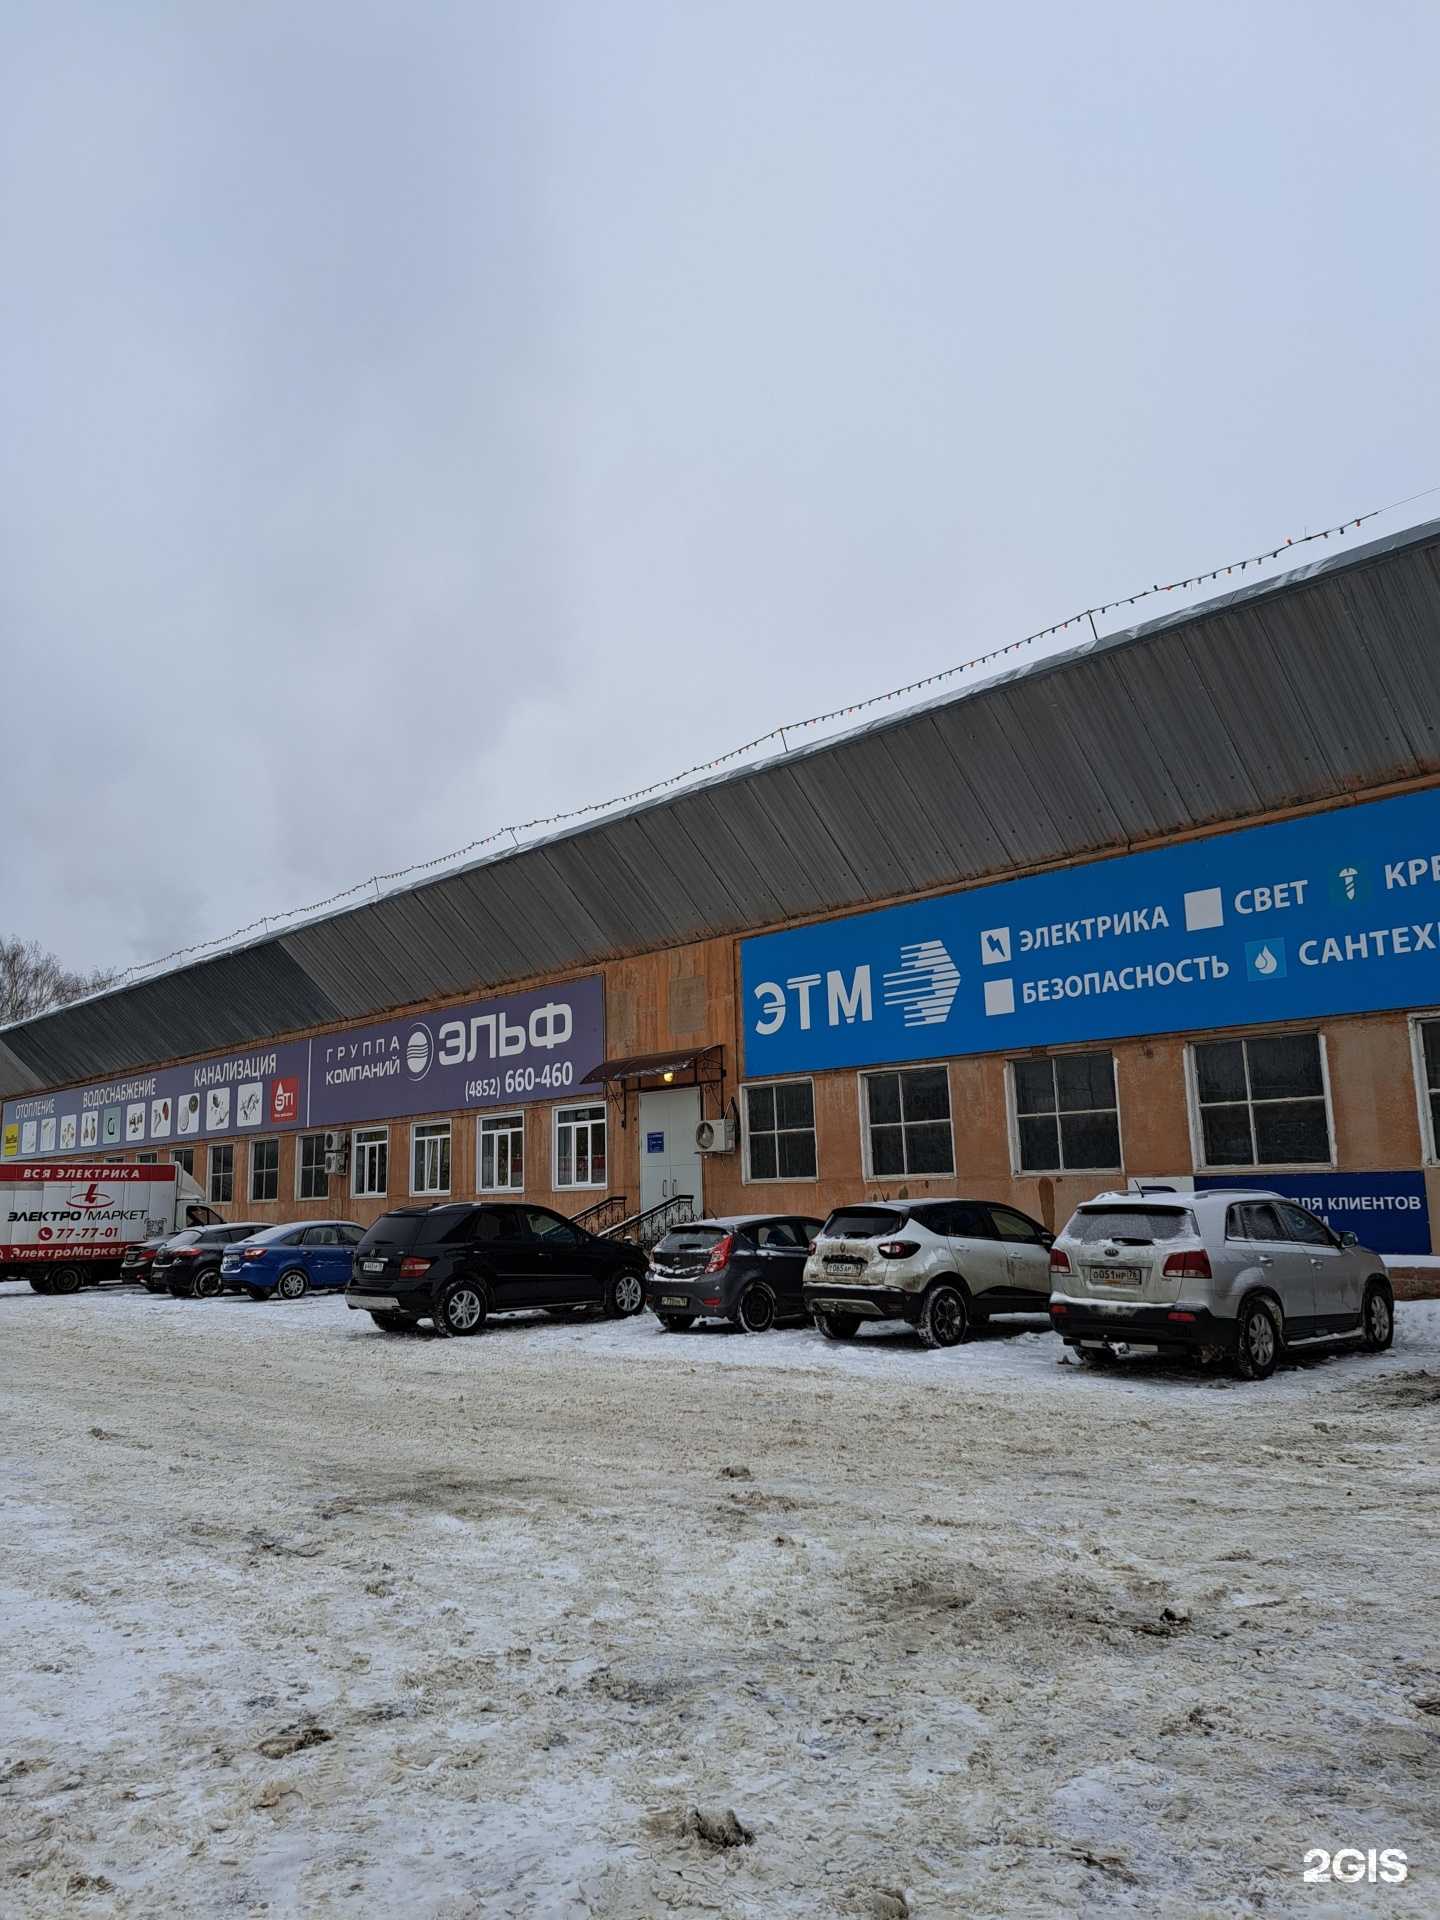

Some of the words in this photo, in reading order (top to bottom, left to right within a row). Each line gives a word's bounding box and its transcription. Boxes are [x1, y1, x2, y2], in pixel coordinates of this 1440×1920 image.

[1234, 879, 1309, 915] СВЕТ
[1019, 906, 1169, 952] ЭЛЕКТРИКА
[1298, 921, 1440, 966] САНТЕХ
[1022, 955, 1230, 1004] БЕЗОПАСНОСТЬ
[753, 964, 873, 1036] ЭТМ
[326, 1035, 401, 1063] ГРУППА
[438, 1002, 573, 1066] ЭЛЬФ
[194, 1053, 277, 1087] КАНАЛИЗАЦИЯ
[325, 1056, 401, 1086] КОМПАНИЙ
[465, 1076, 501, 1102] (4852)
[505, 1061, 574, 1094] 660-460
[15, 1098, 55, 1120] ОТОПЛЕНИЕ
[82, 1078, 157, 1108] ВОДОСНАБЖЕНИЕ
[23, 1168, 51, 1179] ВСЯ
[57, 1168, 141, 1179] ЭЛЕКТРИКА
[8, 1211, 82, 1222] ЭЛЕКТРО
[87, 1209, 148, 1221] МАРКЕТ
[1328, 1196, 1422, 1210] КЛИЕНТОВ
[56, 1227, 118, 1239] 77-77-01
